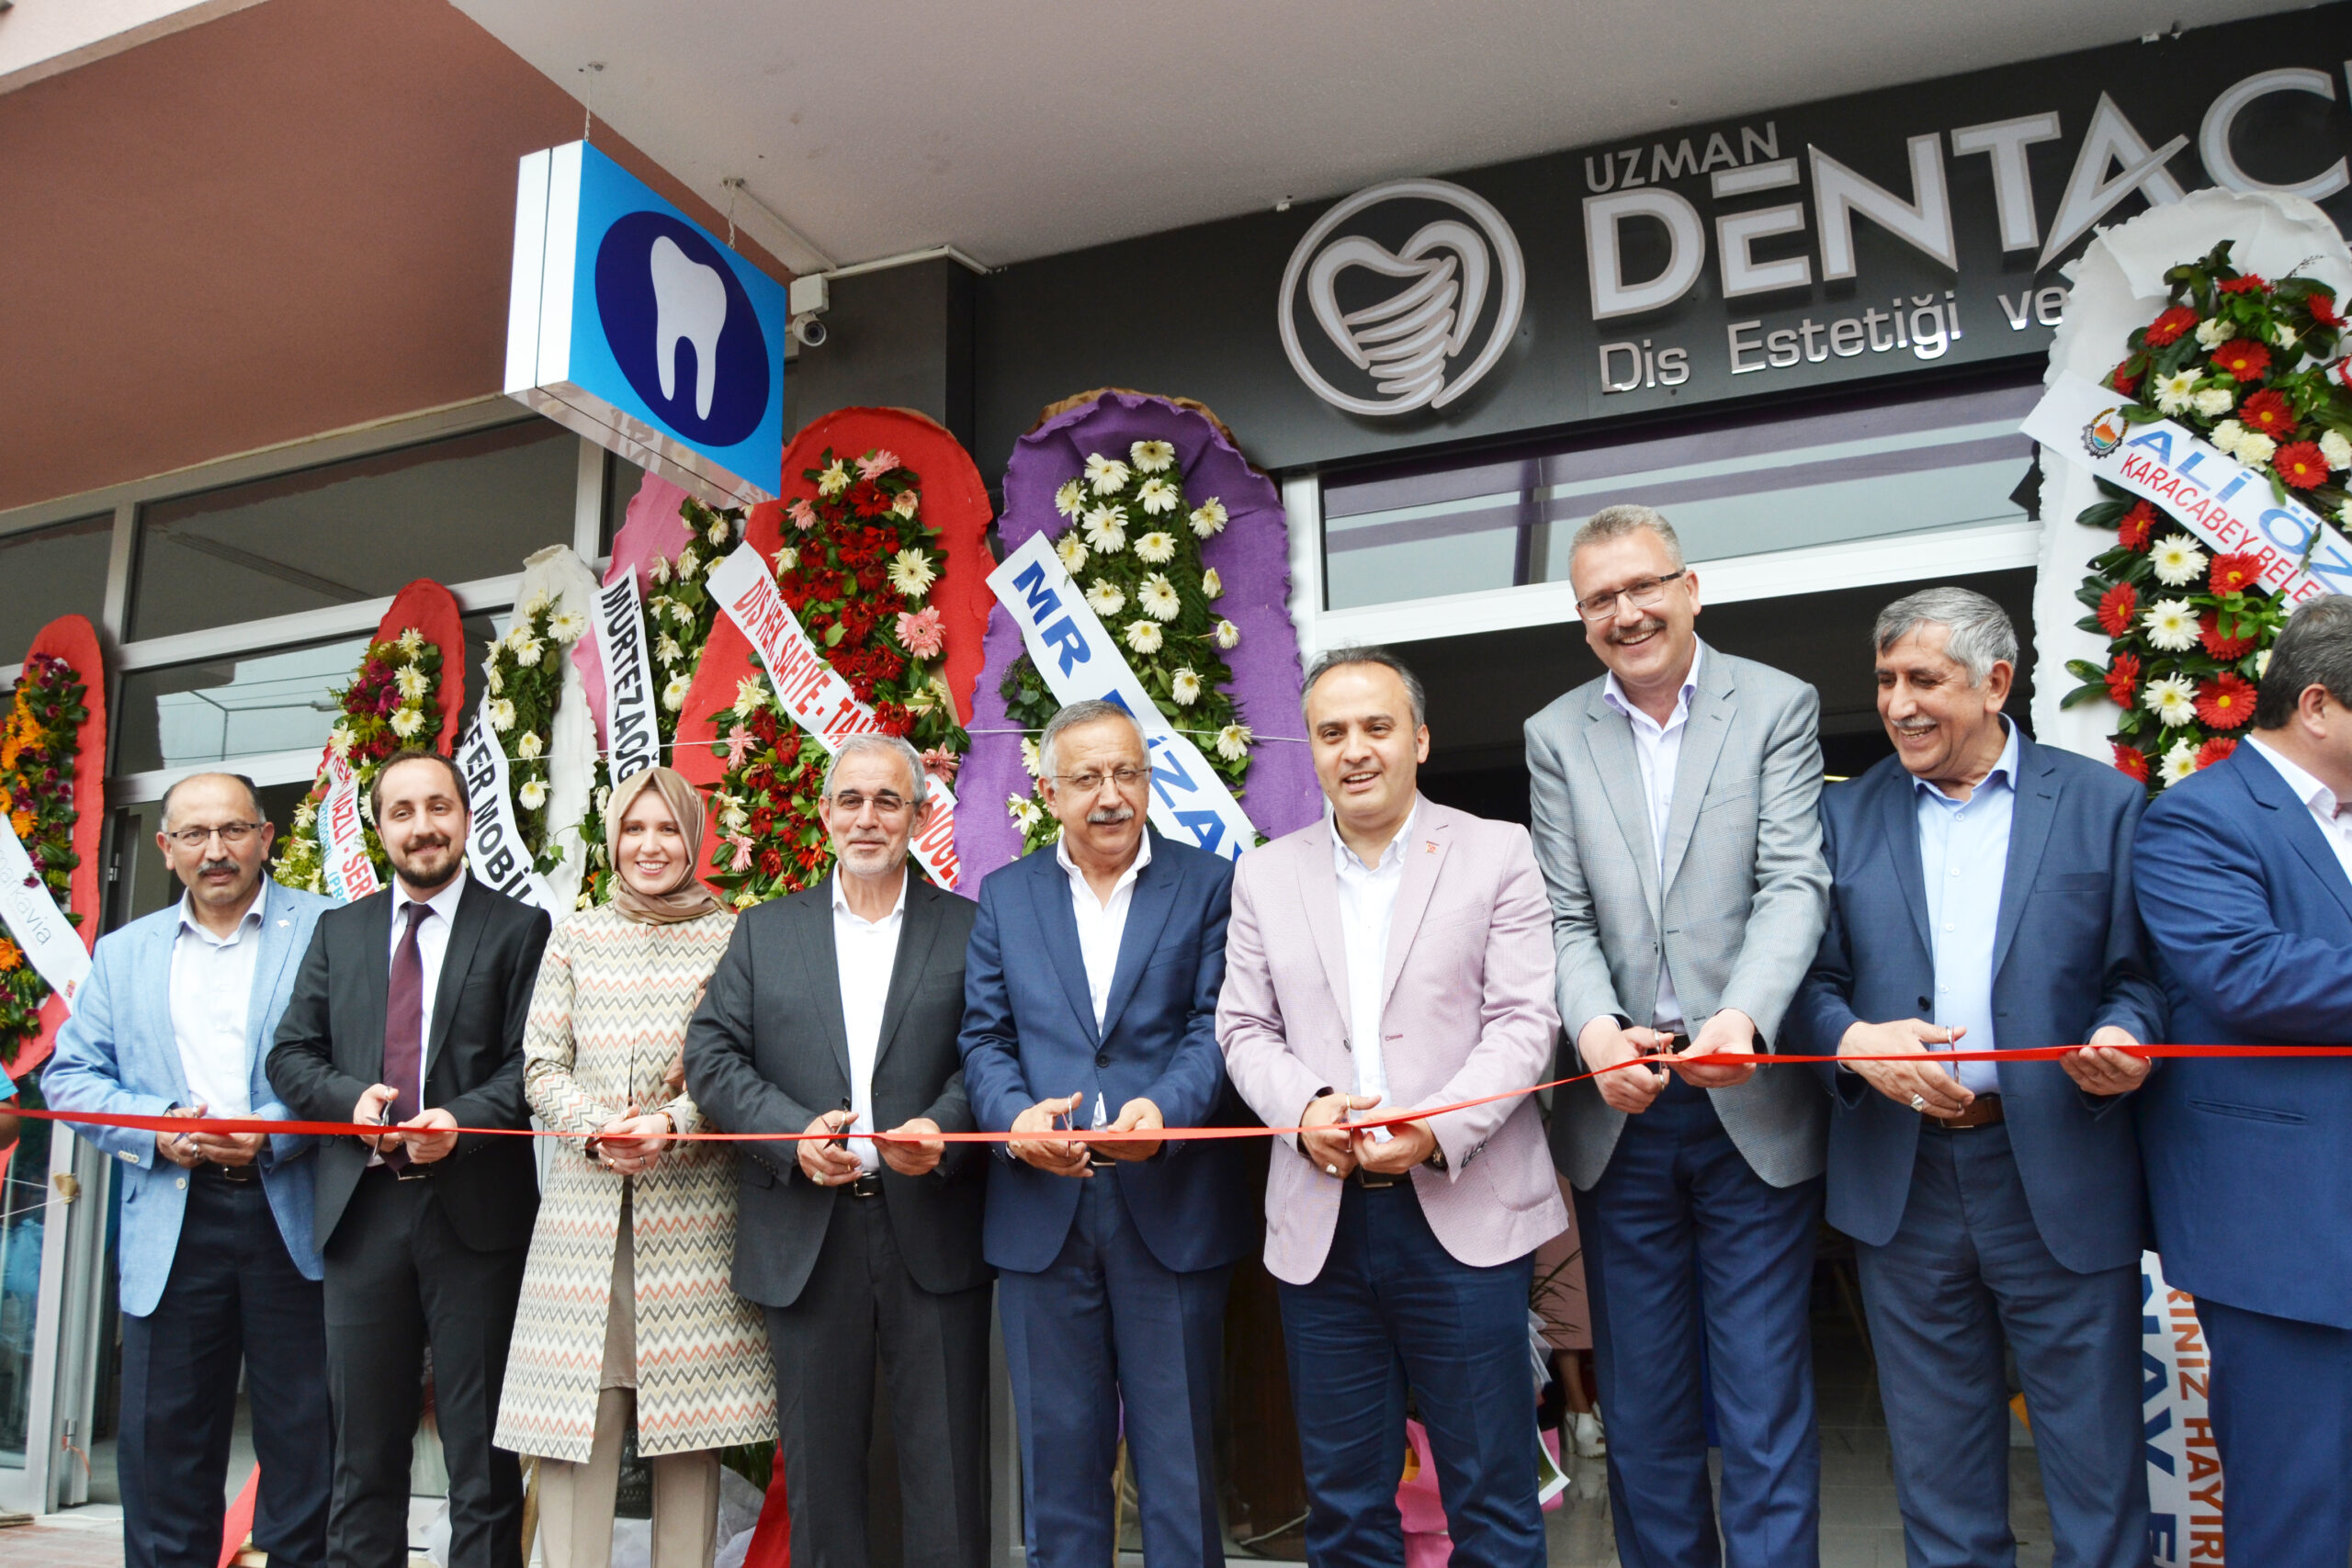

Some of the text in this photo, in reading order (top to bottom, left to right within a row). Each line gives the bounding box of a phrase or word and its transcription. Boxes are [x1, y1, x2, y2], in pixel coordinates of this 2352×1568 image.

[1582, 60, 2352, 321] DENTAC
[1585, 121, 1780, 193] UZMAN
[1727, 290, 1962, 375] Estetiği
[1998, 286, 2069, 331] ve
[2126, 429, 2254, 503] ALİ
[2120, 452, 2328, 604] KARACABEY BELE
[1012, 559, 1091, 680] MR
